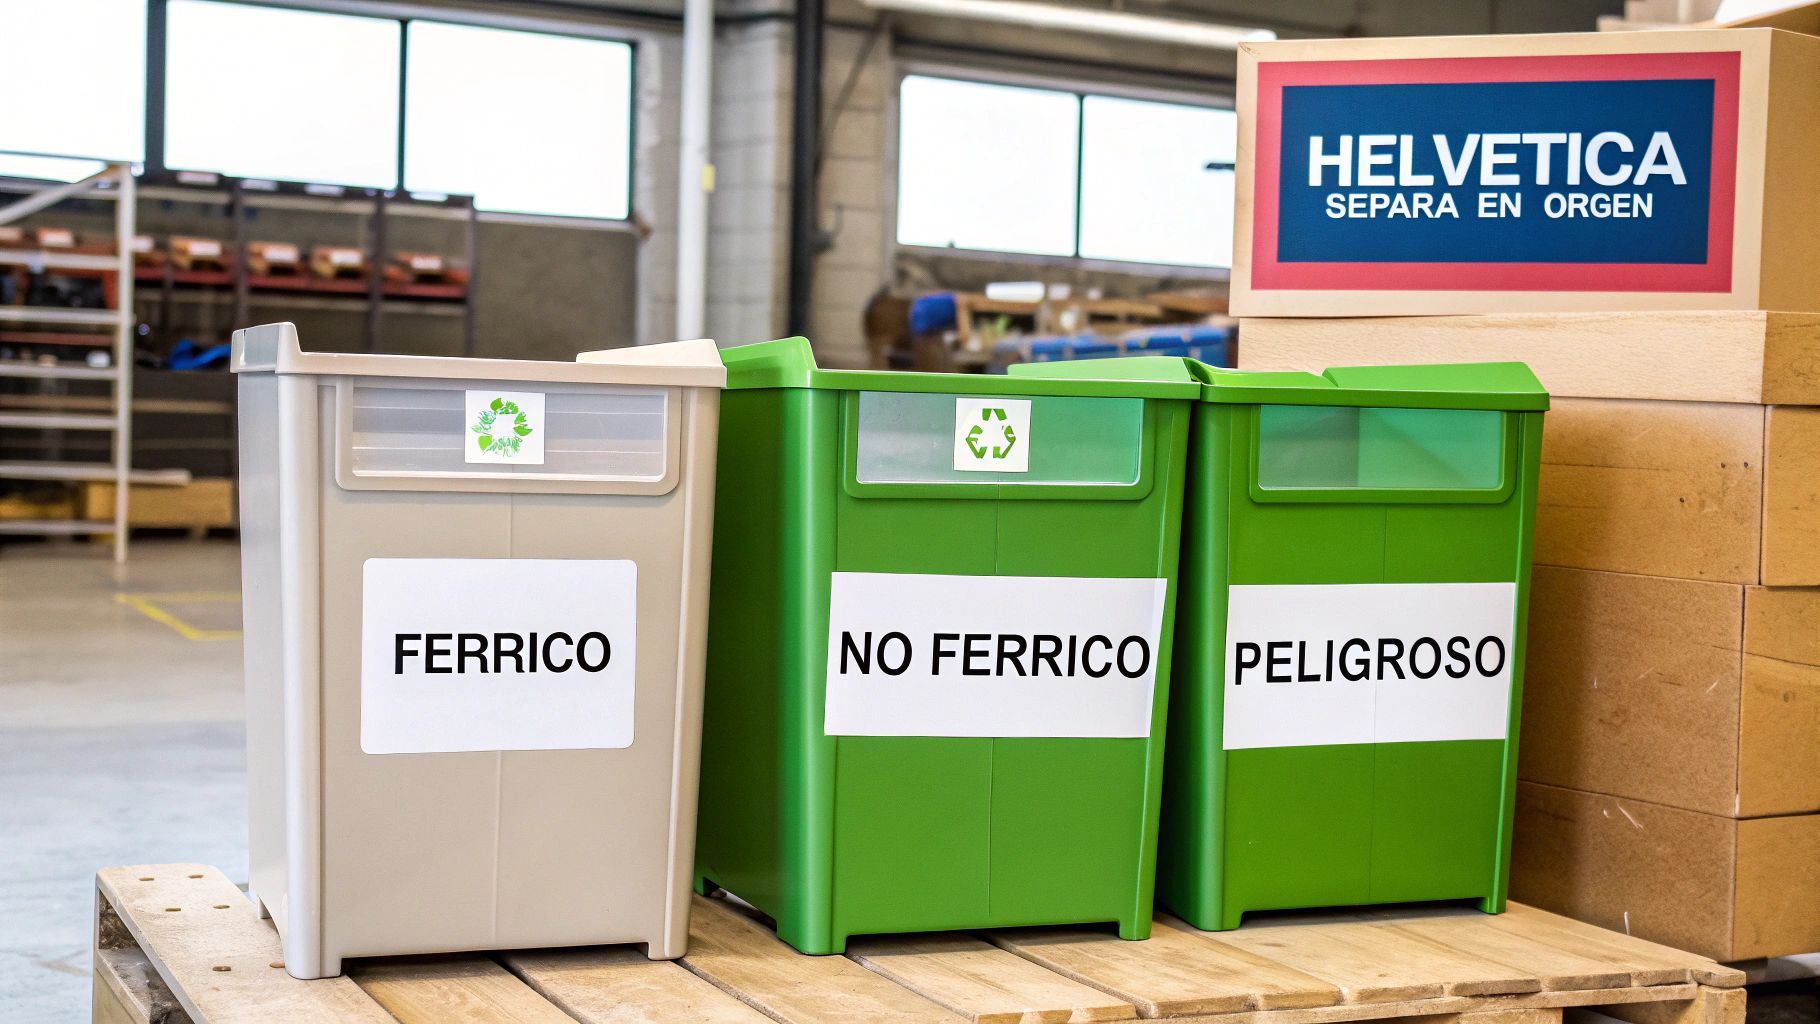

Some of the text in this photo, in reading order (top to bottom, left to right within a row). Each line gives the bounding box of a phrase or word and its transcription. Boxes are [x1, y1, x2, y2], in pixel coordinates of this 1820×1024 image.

[1308, 131, 1688, 187] HELVETICA
[1325, 192, 1653, 219] SEPARA EN ORGEN
[394, 631, 611, 675] FERRICO
[839, 631, 1151, 679] NO FERRICO
[1234, 635, 1506, 686] PELIGROSO
